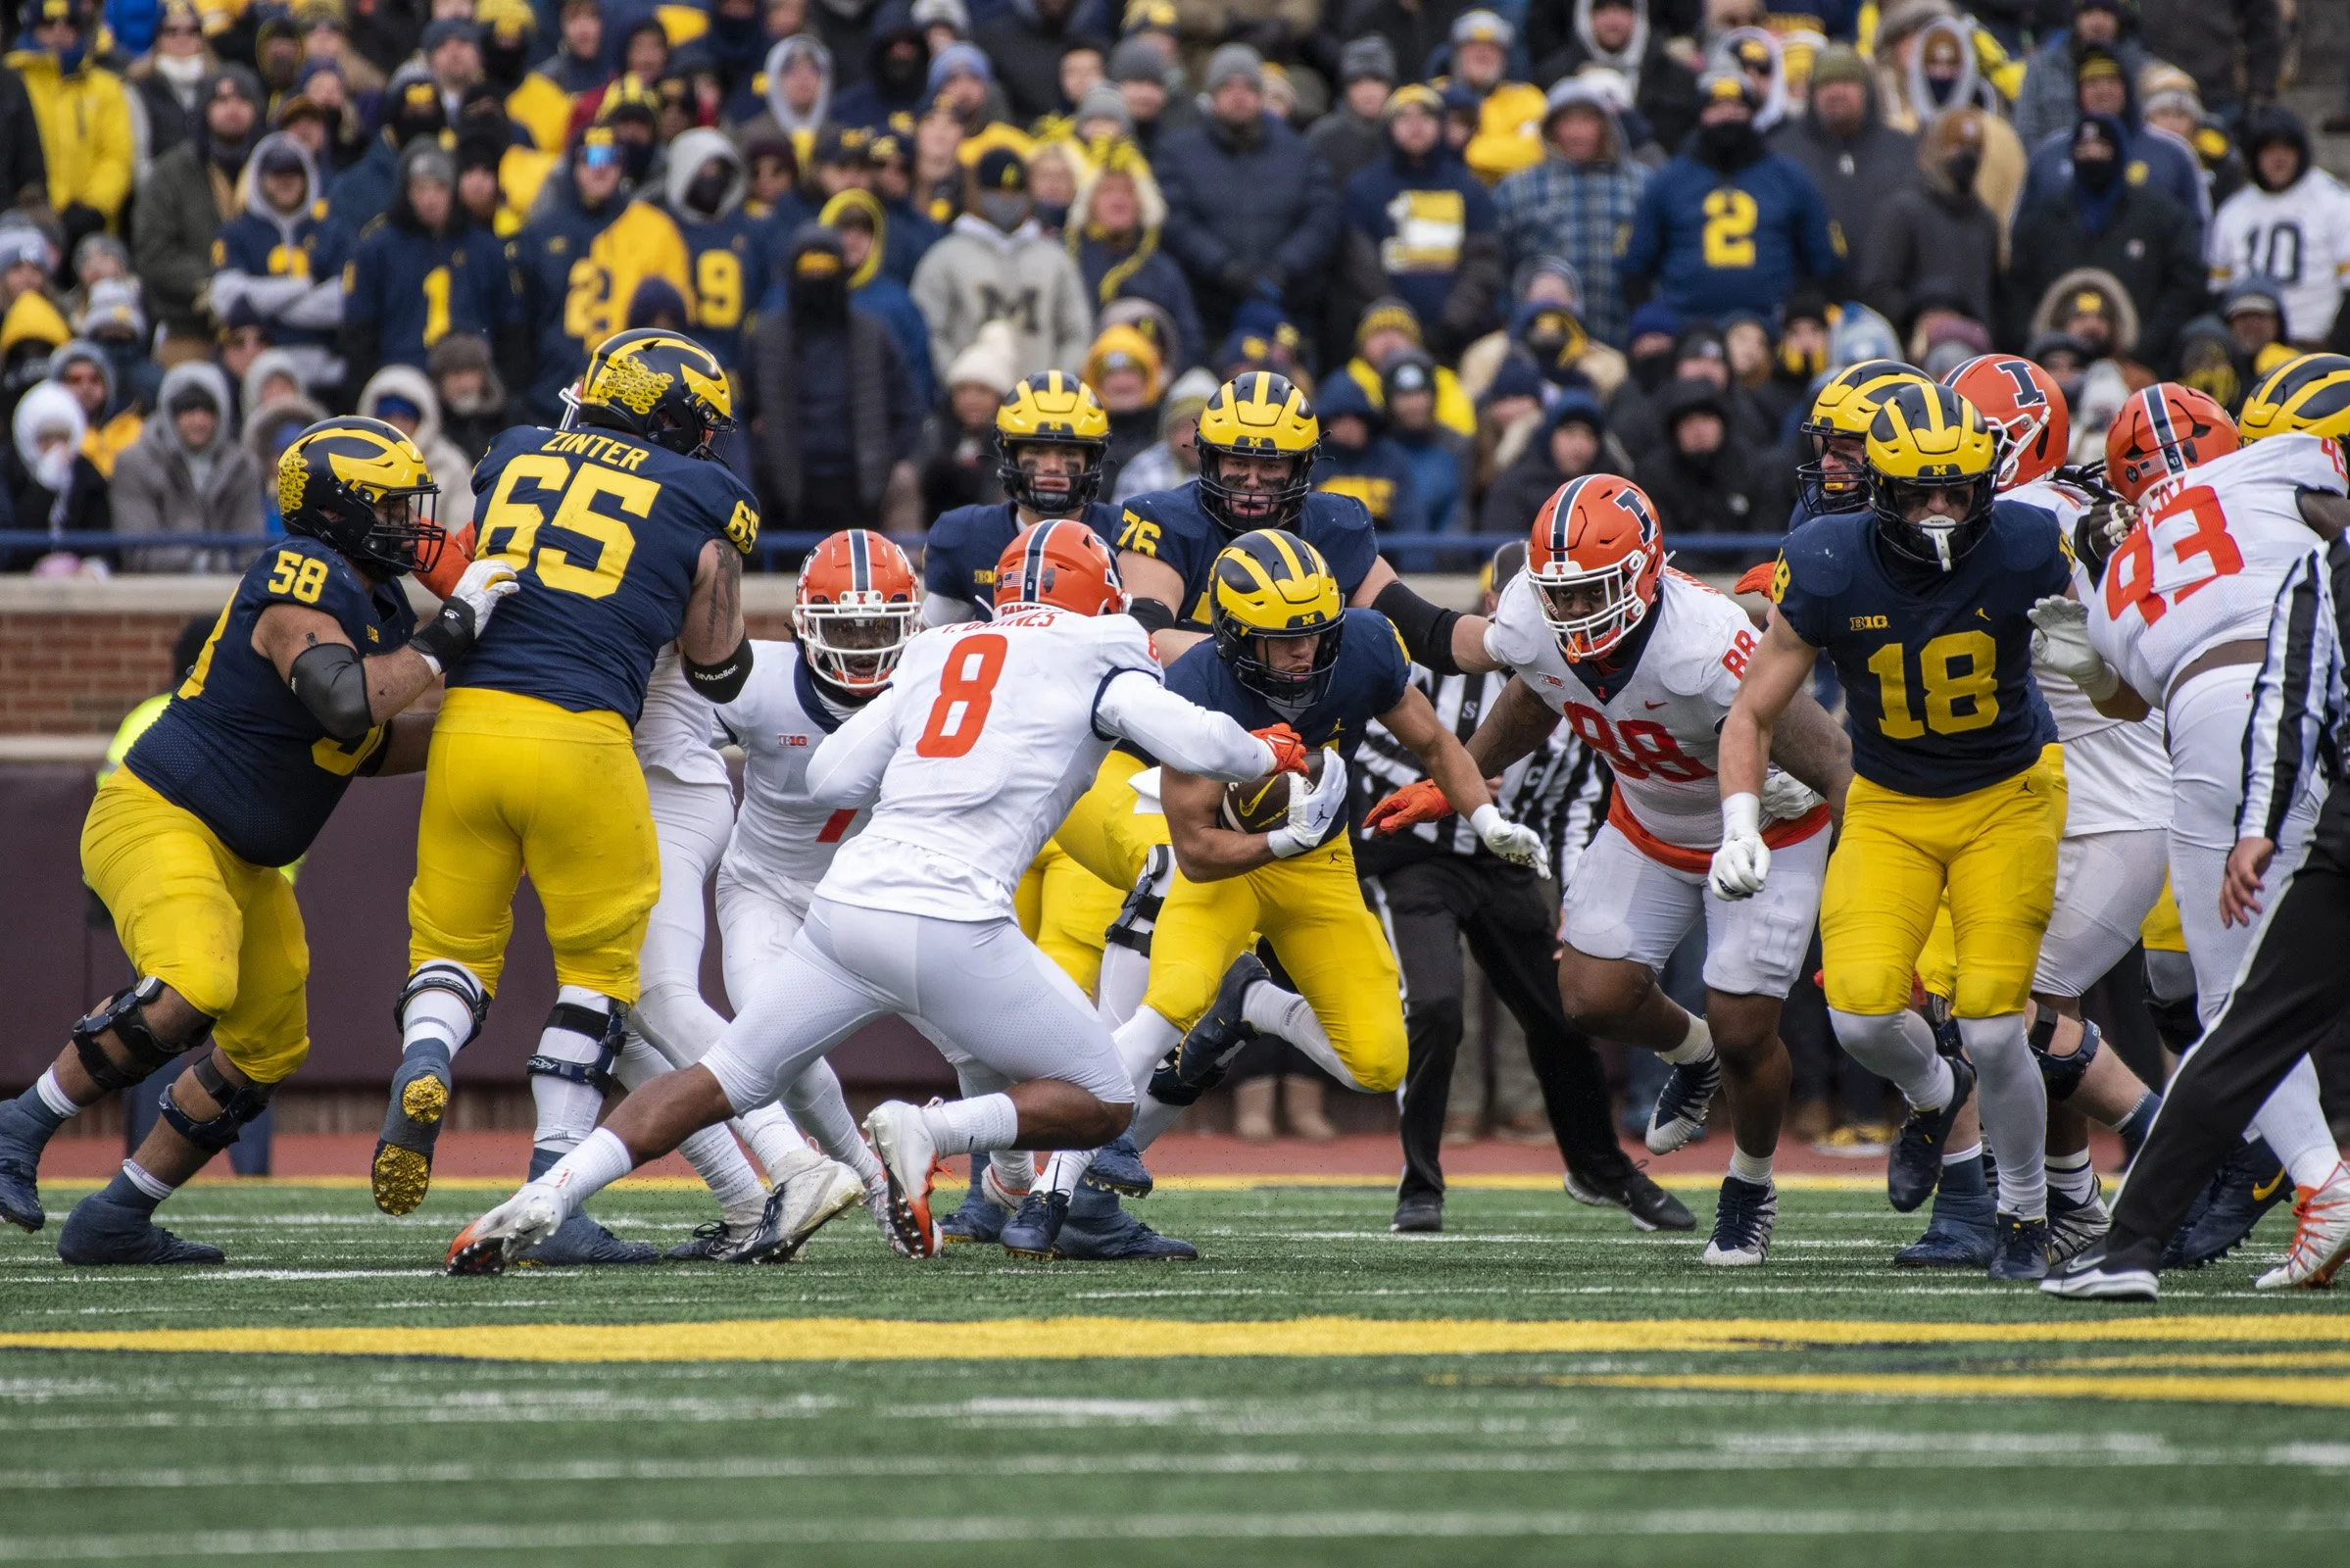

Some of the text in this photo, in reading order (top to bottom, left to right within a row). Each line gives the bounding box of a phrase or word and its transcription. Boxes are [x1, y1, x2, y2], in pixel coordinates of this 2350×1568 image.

[1702, 189, 1758, 270] 2
[2248, 221, 2301, 285] 10
[422, 266, 451, 348] 1
[1993, 360, 2047, 408] I
[541, 431, 649, 471] ZINTER
[1248, 437, 1262, 447] M
[1933, 465, 1947, 476] M
[474, 454, 661, 600] 65
[724, 500, 760, 555] 65
[1116, 509, 1162, 558] 76
[1613, 487, 1658, 548] I
[269, 550, 329, 605] 58
[2106, 485, 2245, 628] 93
[857, 592, 866, 605] I
[1302, 614, 1315, 625] M
[916, 633, 1007, 758] 8
[1461, 701, 1478, 719] S
[1868, 629, 1999, 740] 18
[1564, 701, 1718, 782] 88
